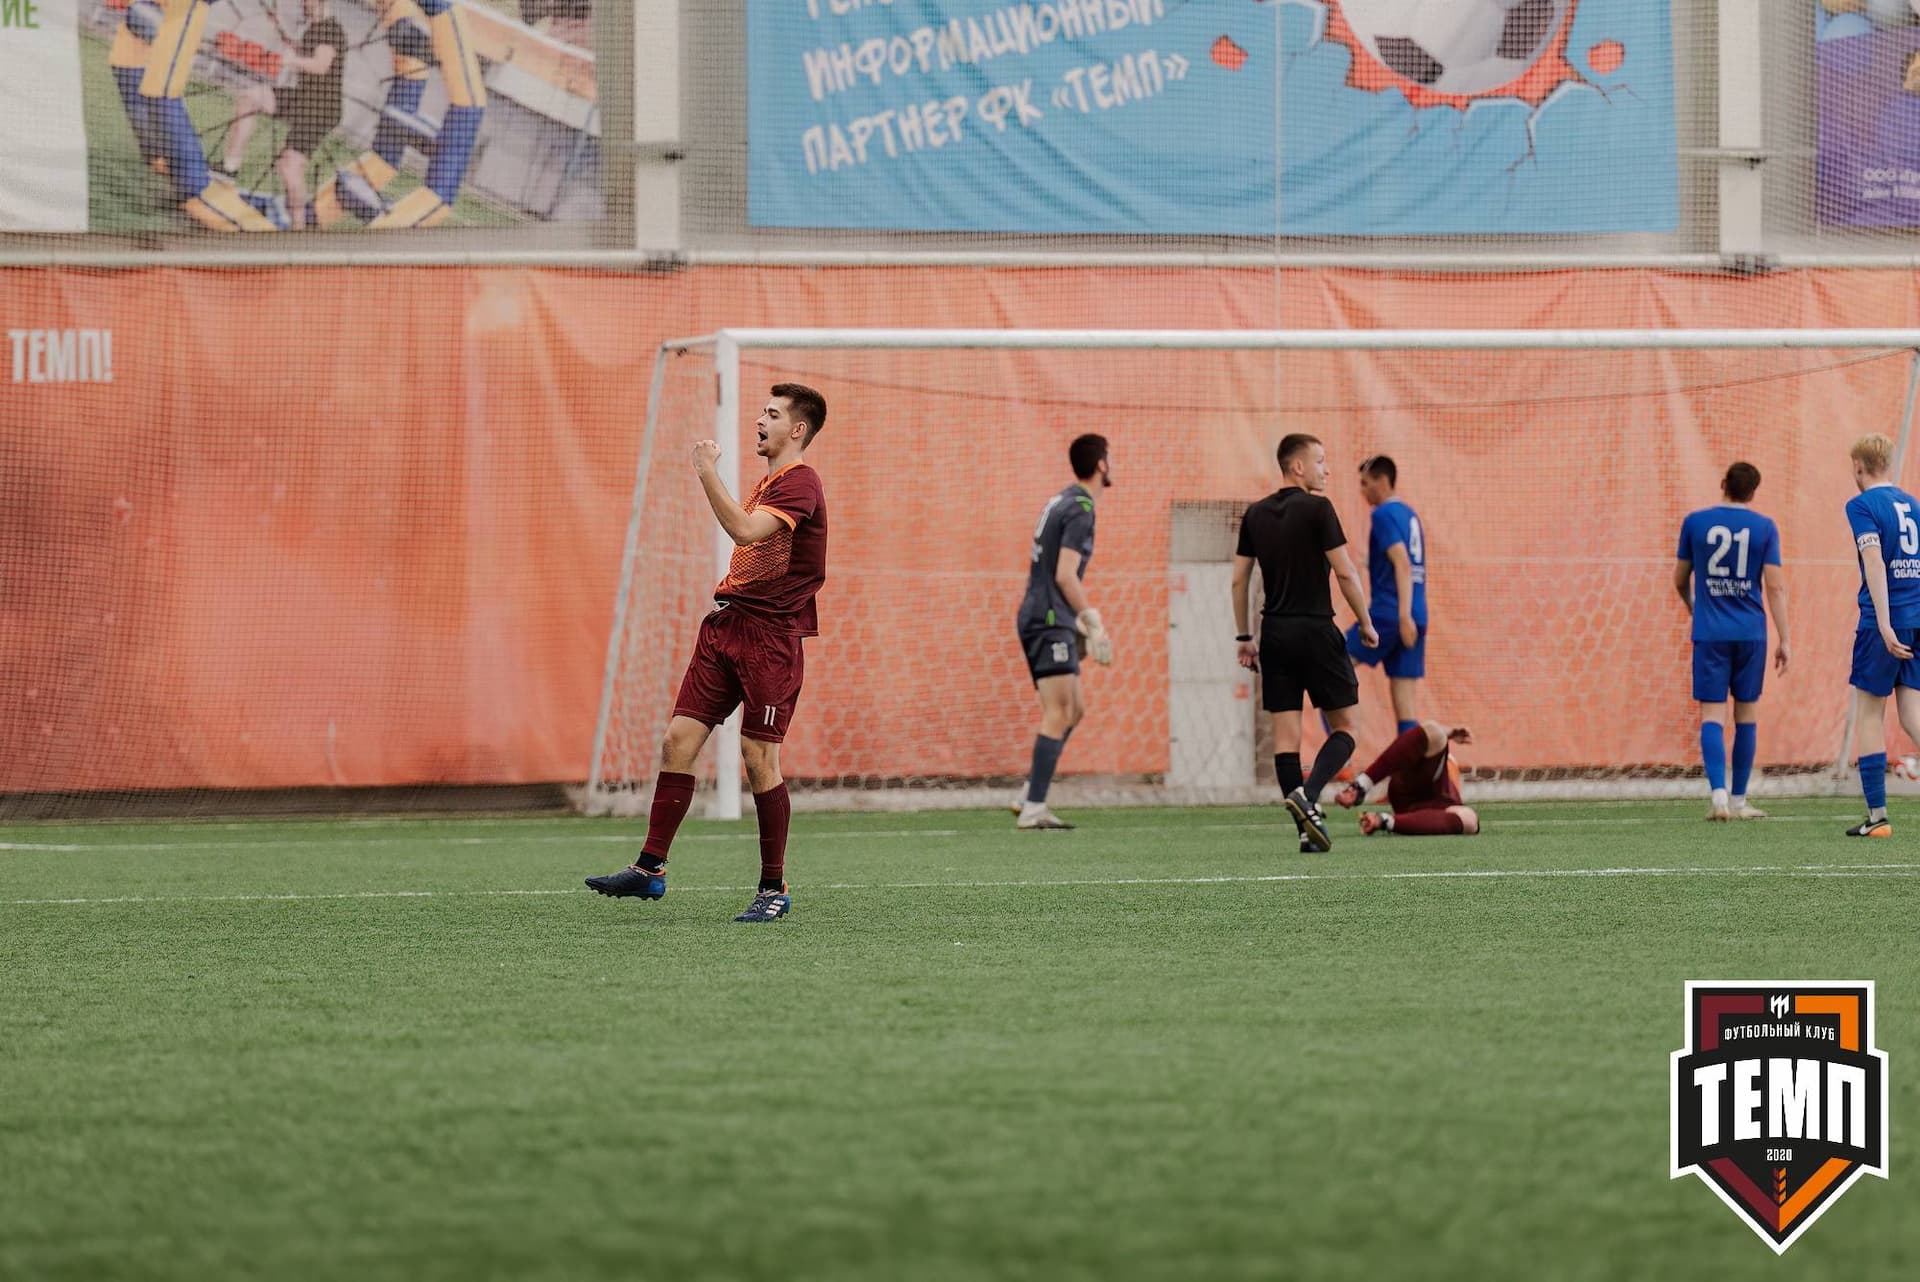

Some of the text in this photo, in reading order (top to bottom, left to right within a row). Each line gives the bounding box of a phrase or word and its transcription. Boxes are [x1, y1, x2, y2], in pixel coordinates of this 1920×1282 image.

[803, 50, 1190, 175] ПАРТНЕР ФК «ТЕМП»
[8, 328, 113, 384] ТЕМП!
[1409, 516, 1423, 564] 4
[1706, 525, 1750, 578] 21
[1893, 501, 1919, 556] 5
[764, 705, 776, 726] 11
